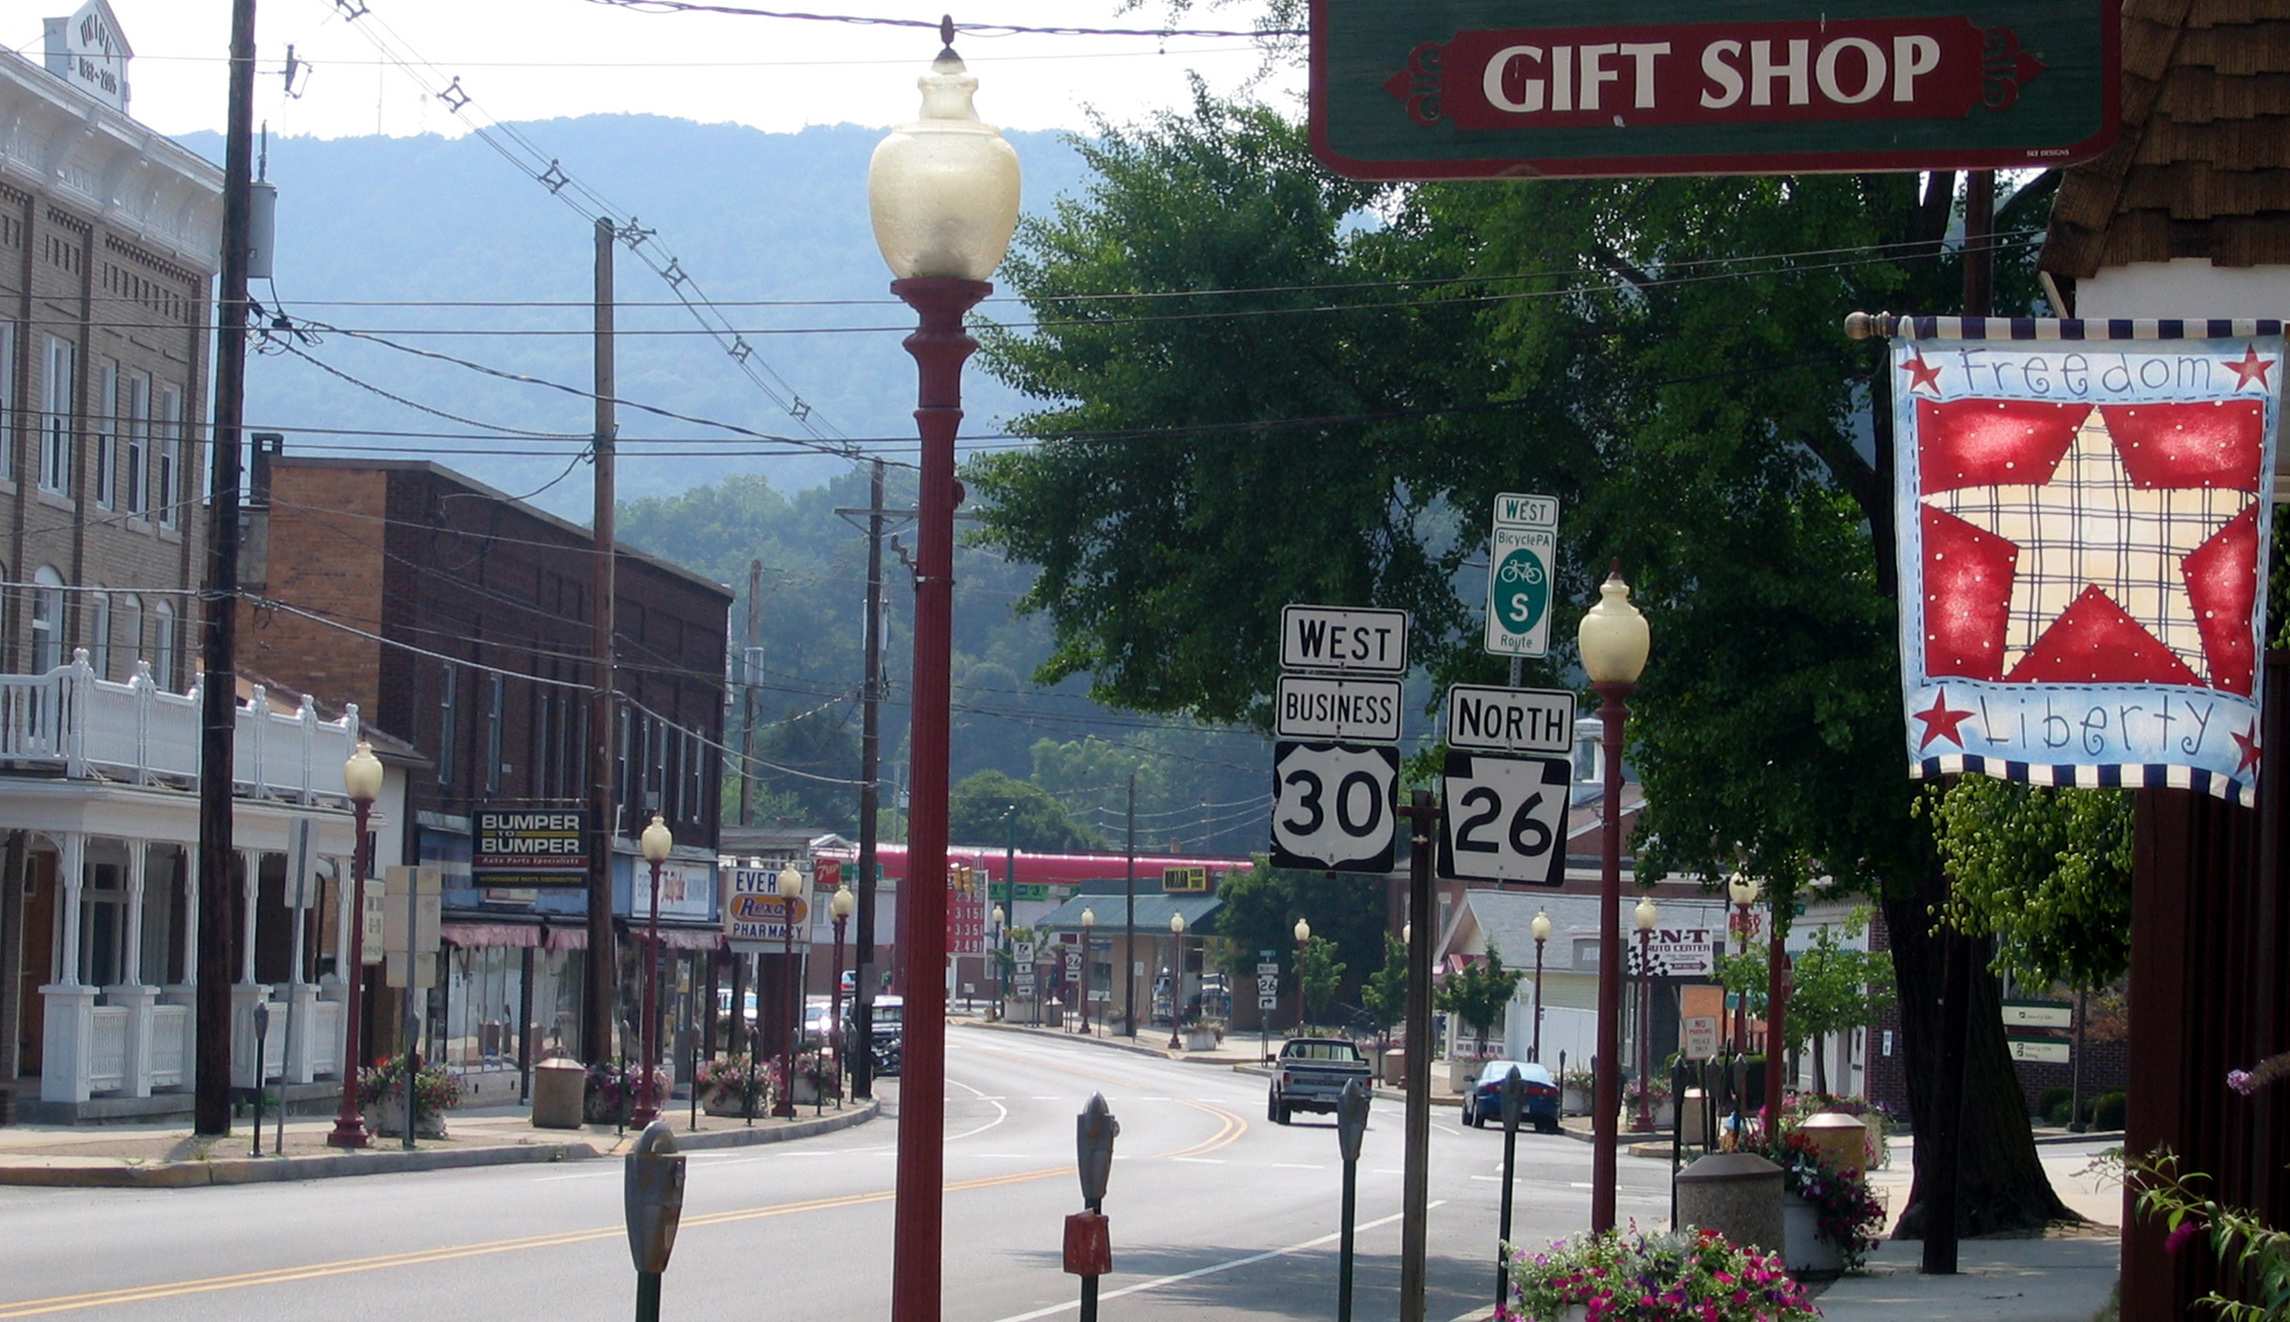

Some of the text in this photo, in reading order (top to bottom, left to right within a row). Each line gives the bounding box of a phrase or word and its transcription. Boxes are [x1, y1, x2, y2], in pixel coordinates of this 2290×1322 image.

[1483, 35, 1941, 112] GIFT SHOP
[1959, 348, 2211, 395] Freedom
[1505, 500, 1547, 522] WEST
[1499, 532, 1549, 548] BicyclePA
[1509, 593, 1529, 622] S
[1298, 619, 1391, 662] WEST
[1501, 634, 1533, 649] Route
[1286, 693, 1392, 725] BUSINESS
[1459, 698, 1564, 742] NORTH
[1980, 695, 2214, 755] Liberty
[1282, 770, 1382, 837] 30
[481, 814, 579, 829] BUMPER
[1456, 787, 1552, 857] 26
[481, 838, 579, 853] BUMPER
[1633, 929, 1710, 943] T-N-T
[1260, 980, 1276, 991] 26
[1695, 1020, 1706, 1028] NO
